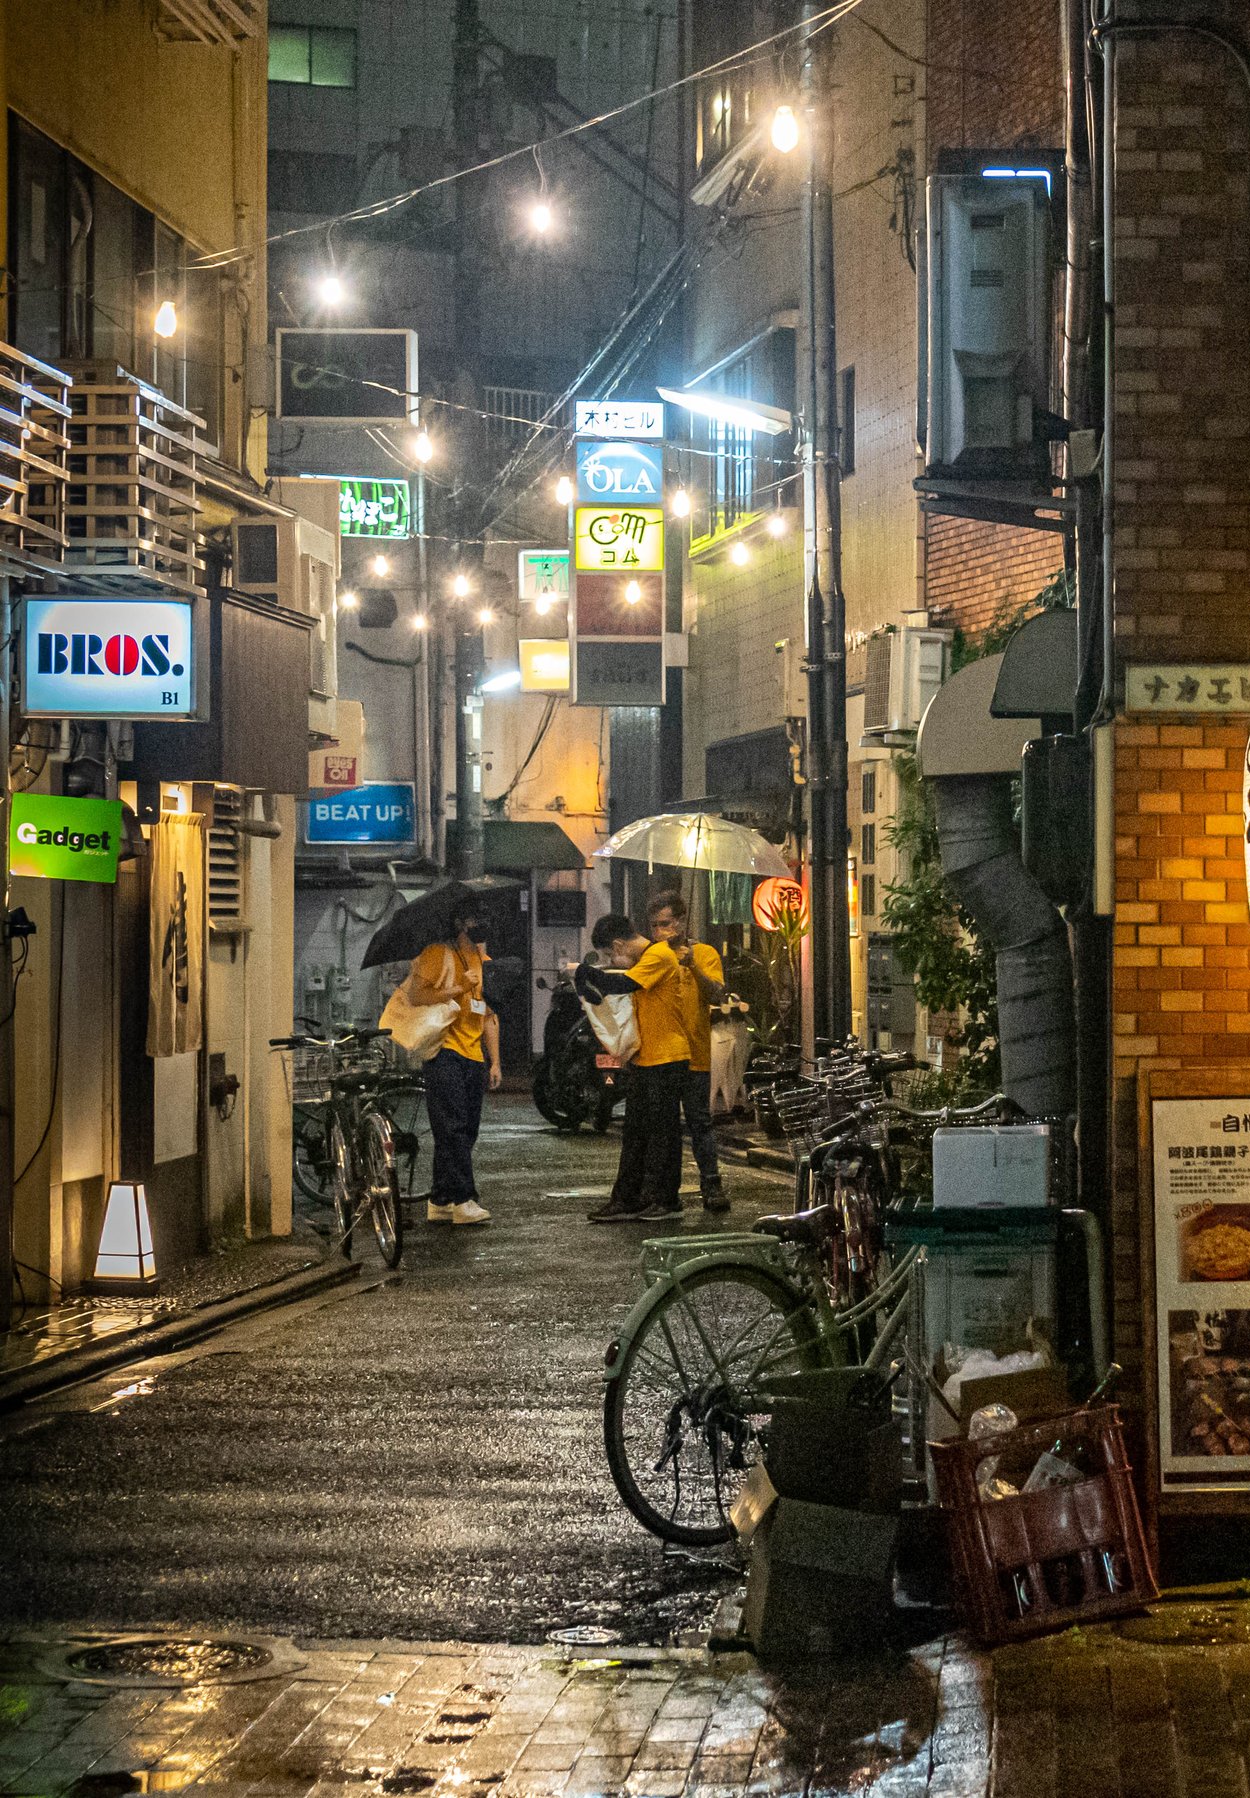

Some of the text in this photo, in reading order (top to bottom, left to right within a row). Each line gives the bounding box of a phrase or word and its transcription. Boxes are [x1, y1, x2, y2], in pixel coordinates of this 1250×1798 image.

[584, 464, 656, 494] OLA
[602, 550, 640, 564] コム
[37, 633, 185, 677] BROS.
[161, 692, 180, 705] B1
[315, 804, 371, 821] BEAT
[17, 822, 111, 852] Gadget
